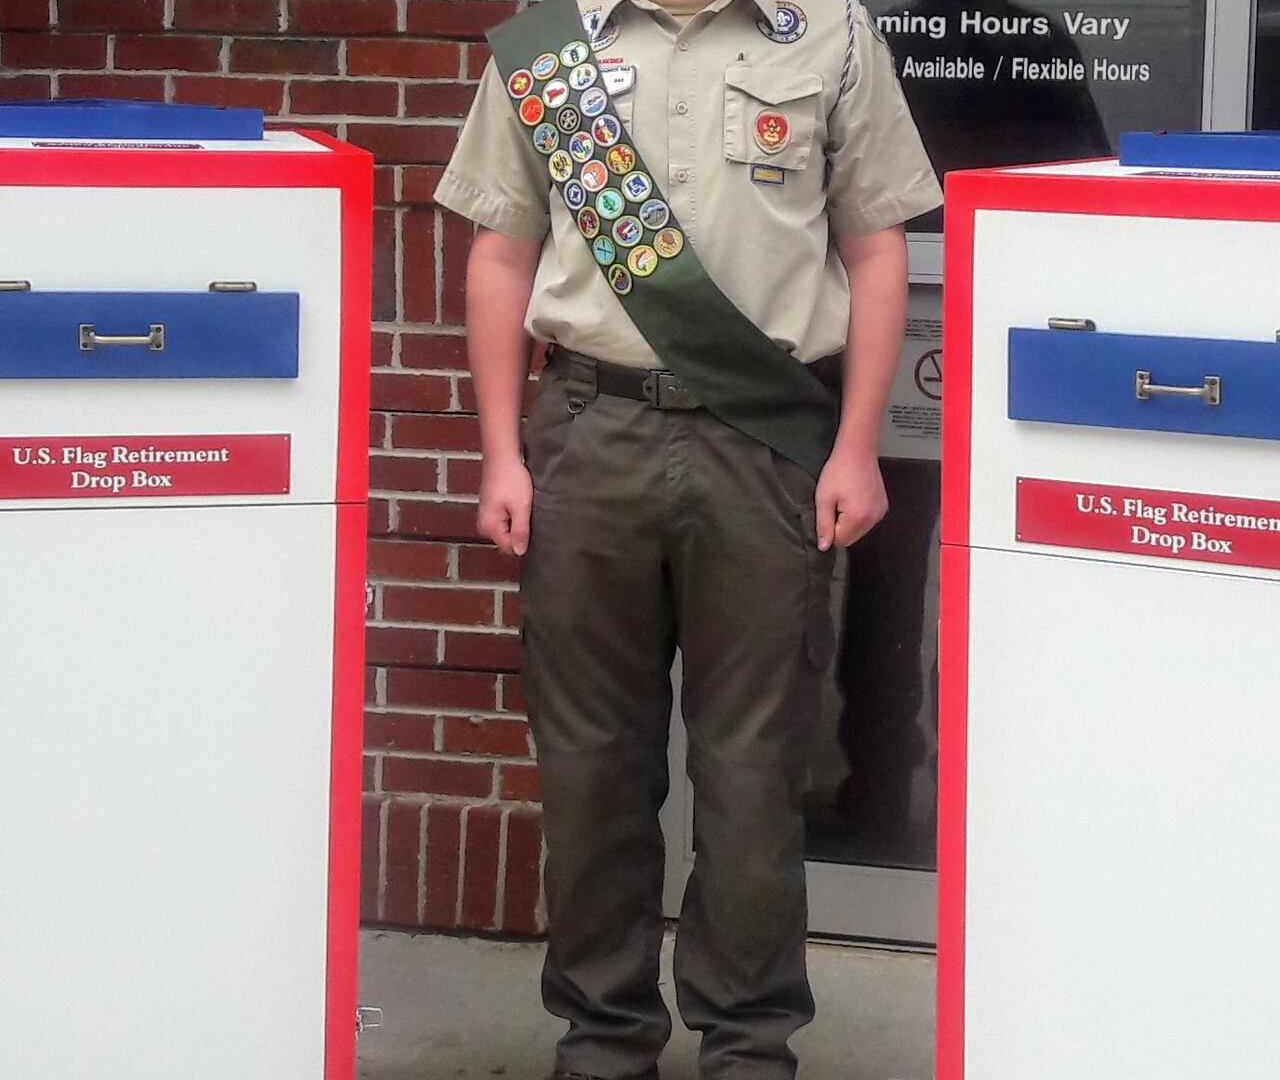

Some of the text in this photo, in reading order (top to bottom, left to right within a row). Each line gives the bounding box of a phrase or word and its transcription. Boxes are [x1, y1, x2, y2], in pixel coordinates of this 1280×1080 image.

[959, 10, 1050, 36] Hours
[1062, 11, 1131, 40] Vary
[901, 54, 1151, 82] Available / Flexible Hours
[11, 446, 229, 469] U.S. Flag Retirement
[70, 470, 172, 493] Drop Box
[1075, 493, 1118, 517] U.S.
[1122, 498, 1168, 526] Flag
[1130, 525, 1233, 554] Drop Box
